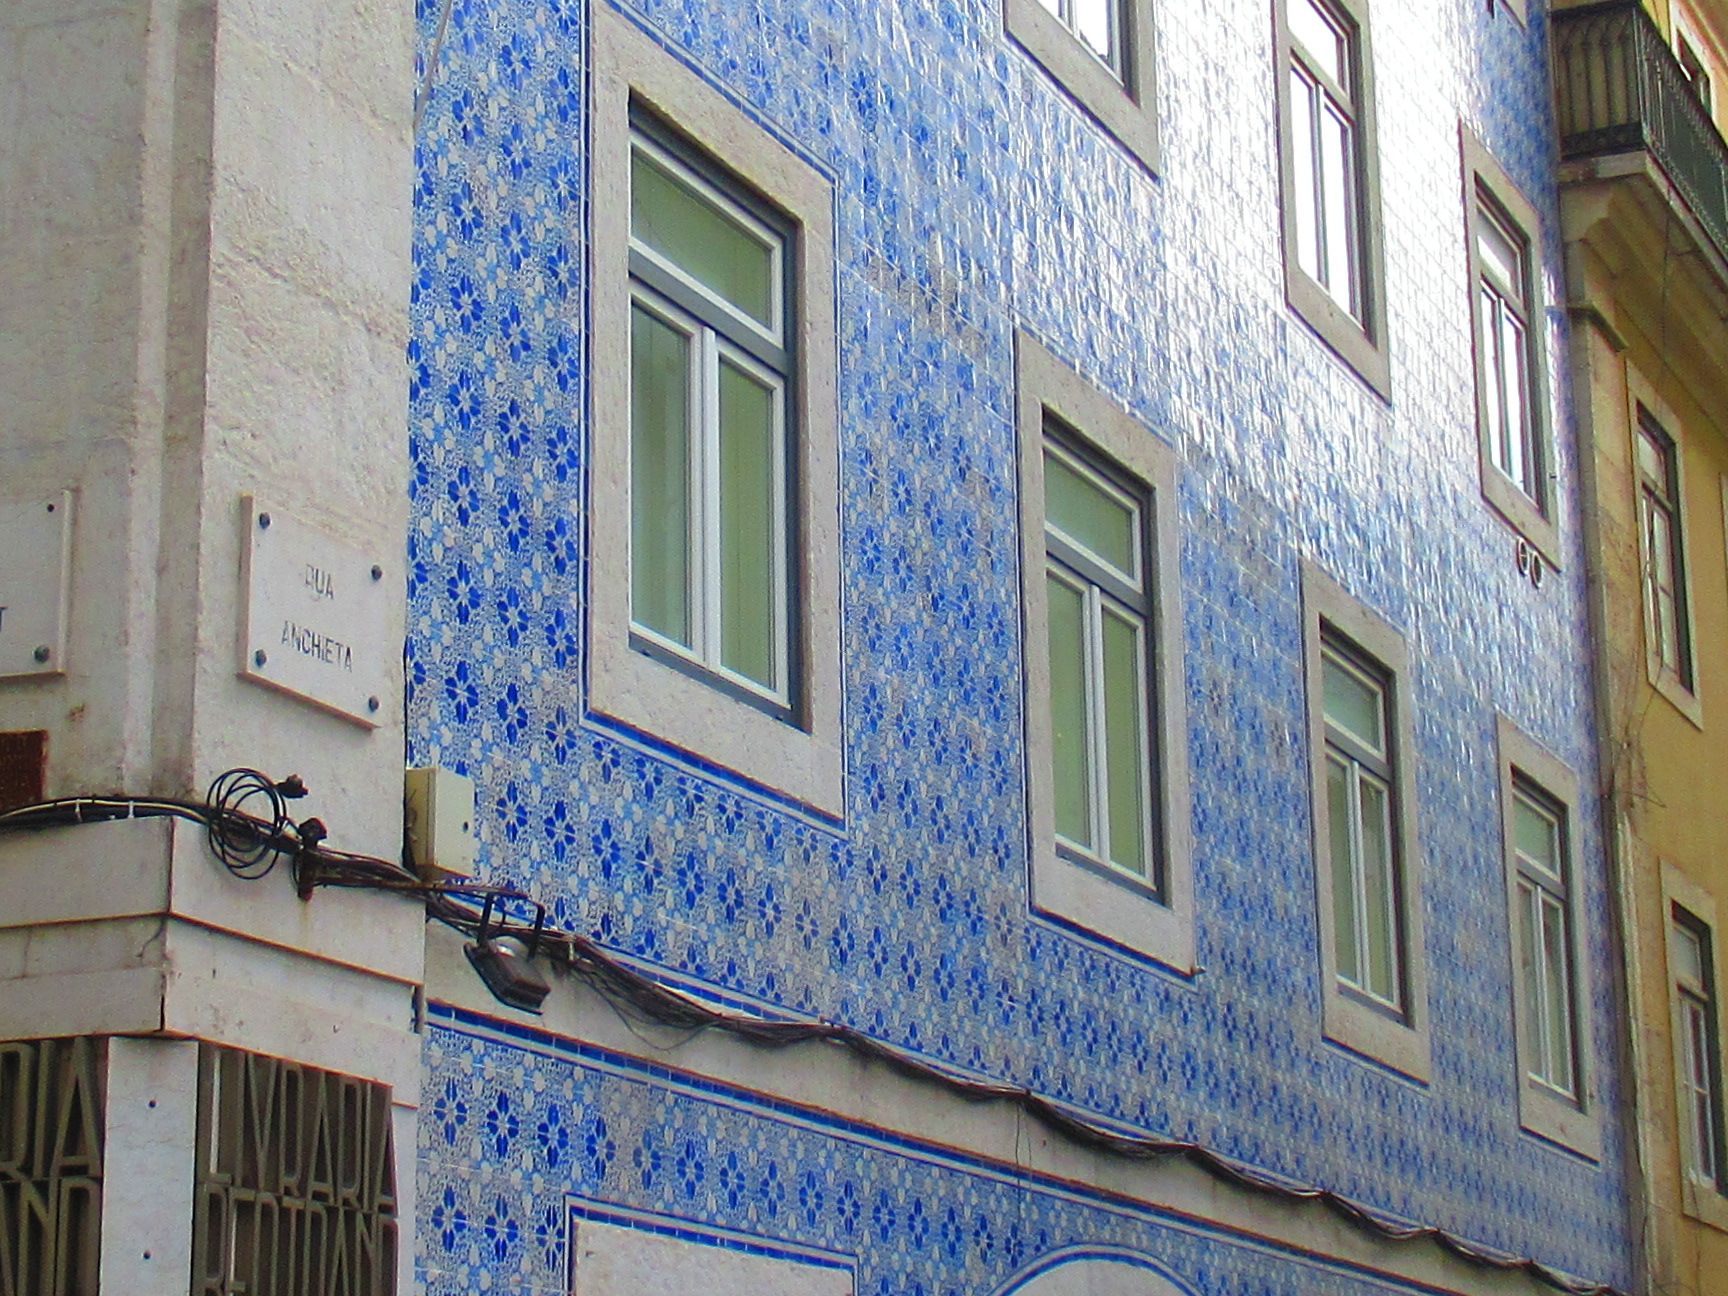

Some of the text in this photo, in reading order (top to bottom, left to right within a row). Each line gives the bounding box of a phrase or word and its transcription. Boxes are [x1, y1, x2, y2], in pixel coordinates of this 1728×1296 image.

[303, 562, 334, 601] RUA
[279, 619, 354, 674] ANCHIETA
[200, 1047, 398, 1216] LIVRARIA
